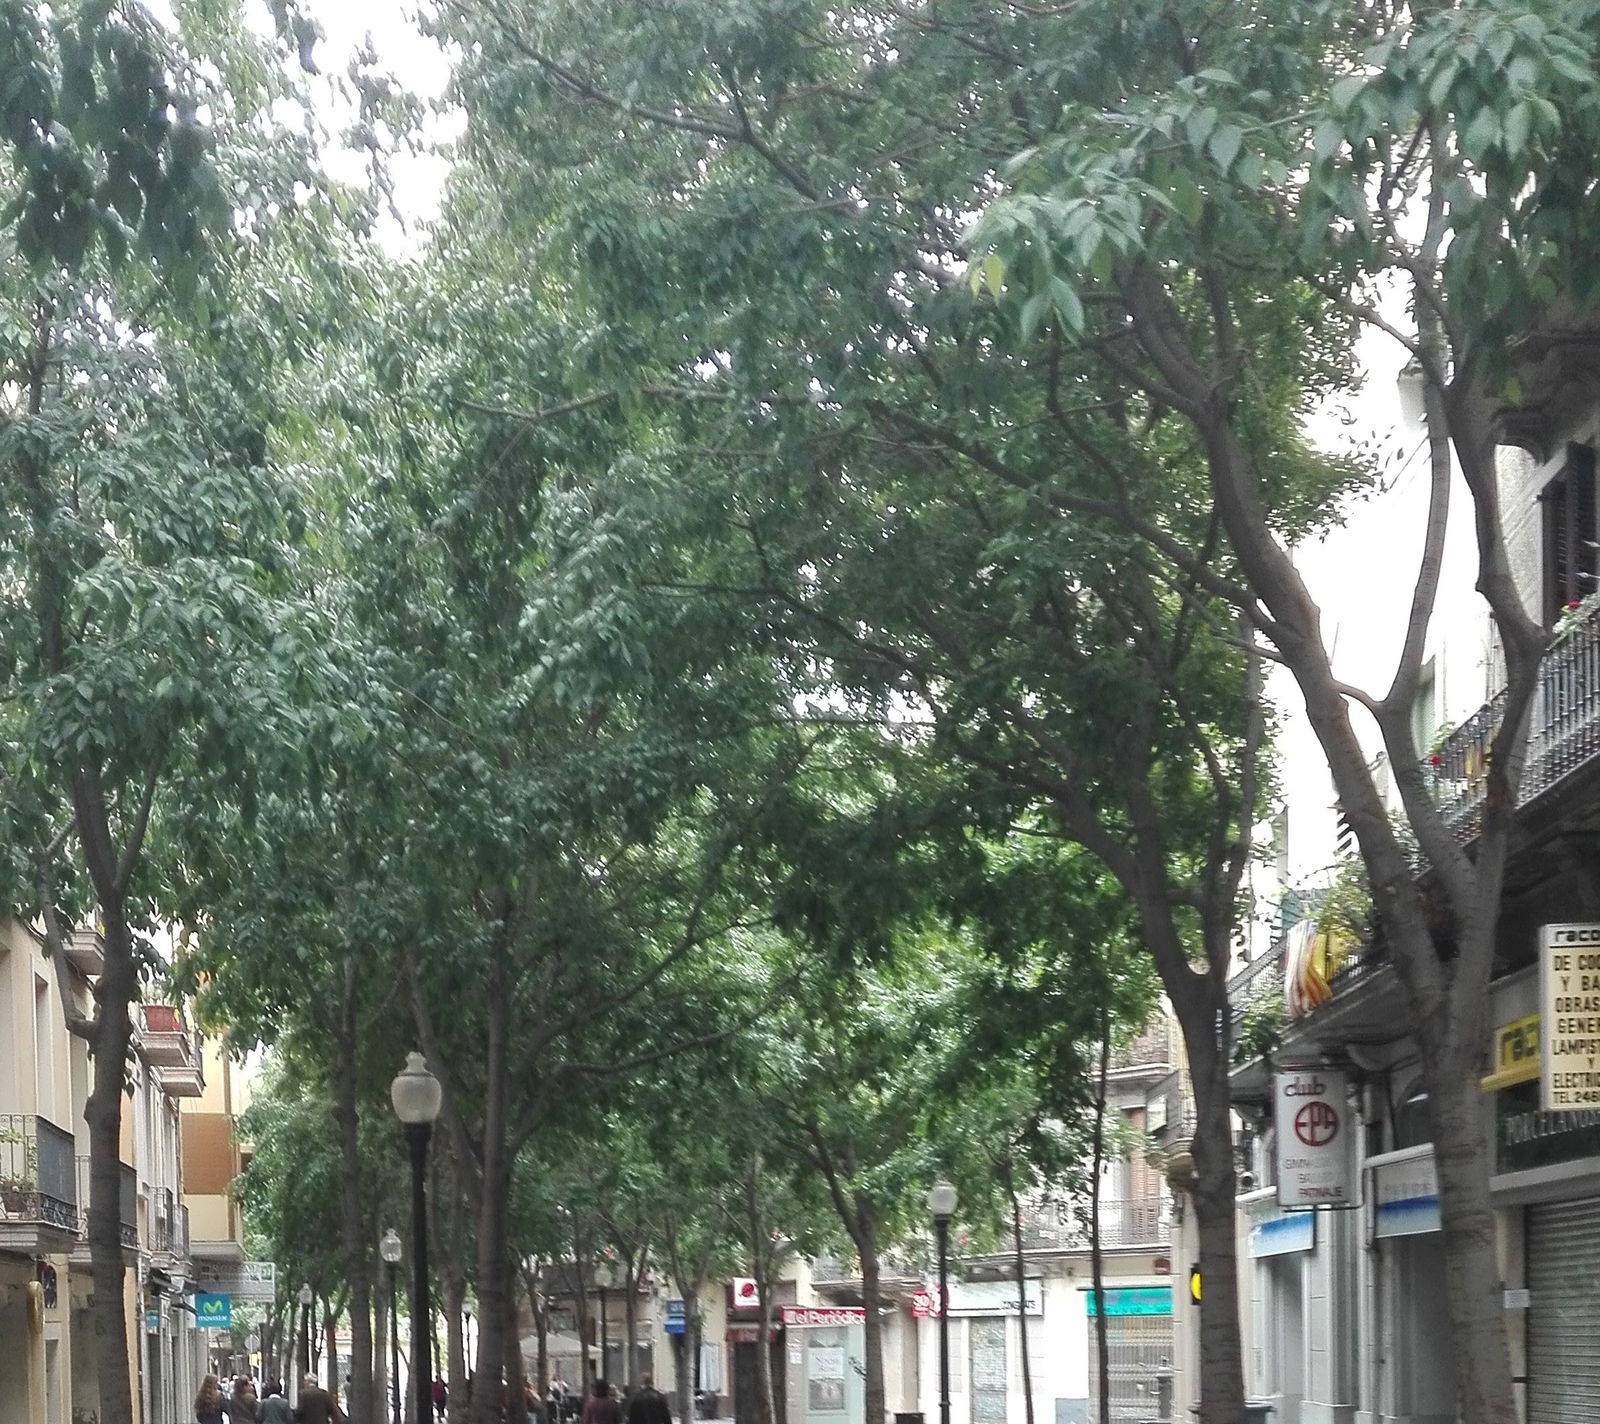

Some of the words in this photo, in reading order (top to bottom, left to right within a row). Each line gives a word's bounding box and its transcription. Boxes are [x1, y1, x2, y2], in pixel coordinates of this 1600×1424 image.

[1554, 955, 1571, 971] DE
[1561, 976, 1570, 992] Y
[1555, 997, 1600, 1013] OBRAS
[1588, 1057, 1595, 1070] Y
[1284, 1076, 1326, 1097] club
